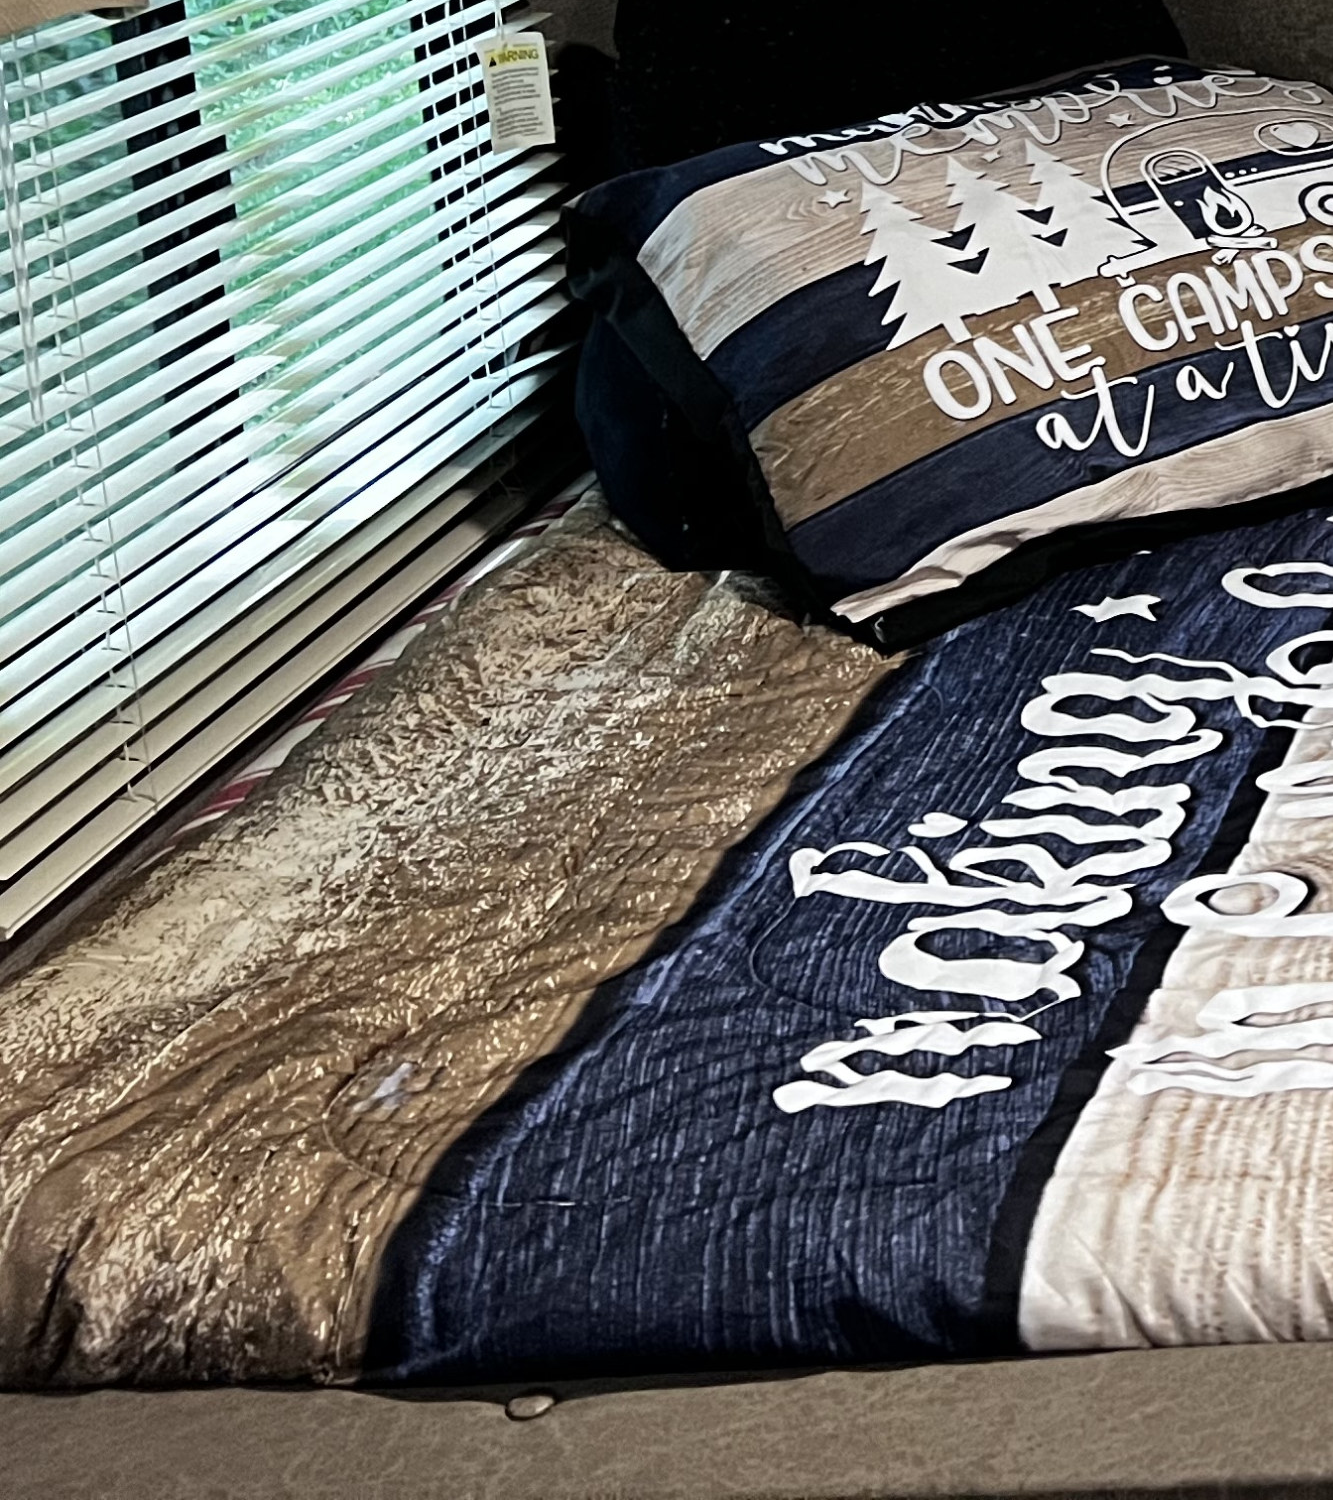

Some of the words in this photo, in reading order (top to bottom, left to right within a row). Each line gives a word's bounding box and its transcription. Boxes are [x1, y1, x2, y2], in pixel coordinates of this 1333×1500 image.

[922, 307, 1106, 421] ONE
[1035, 362, 1155, 459] at
[1176, 360, 1235, 401] a
